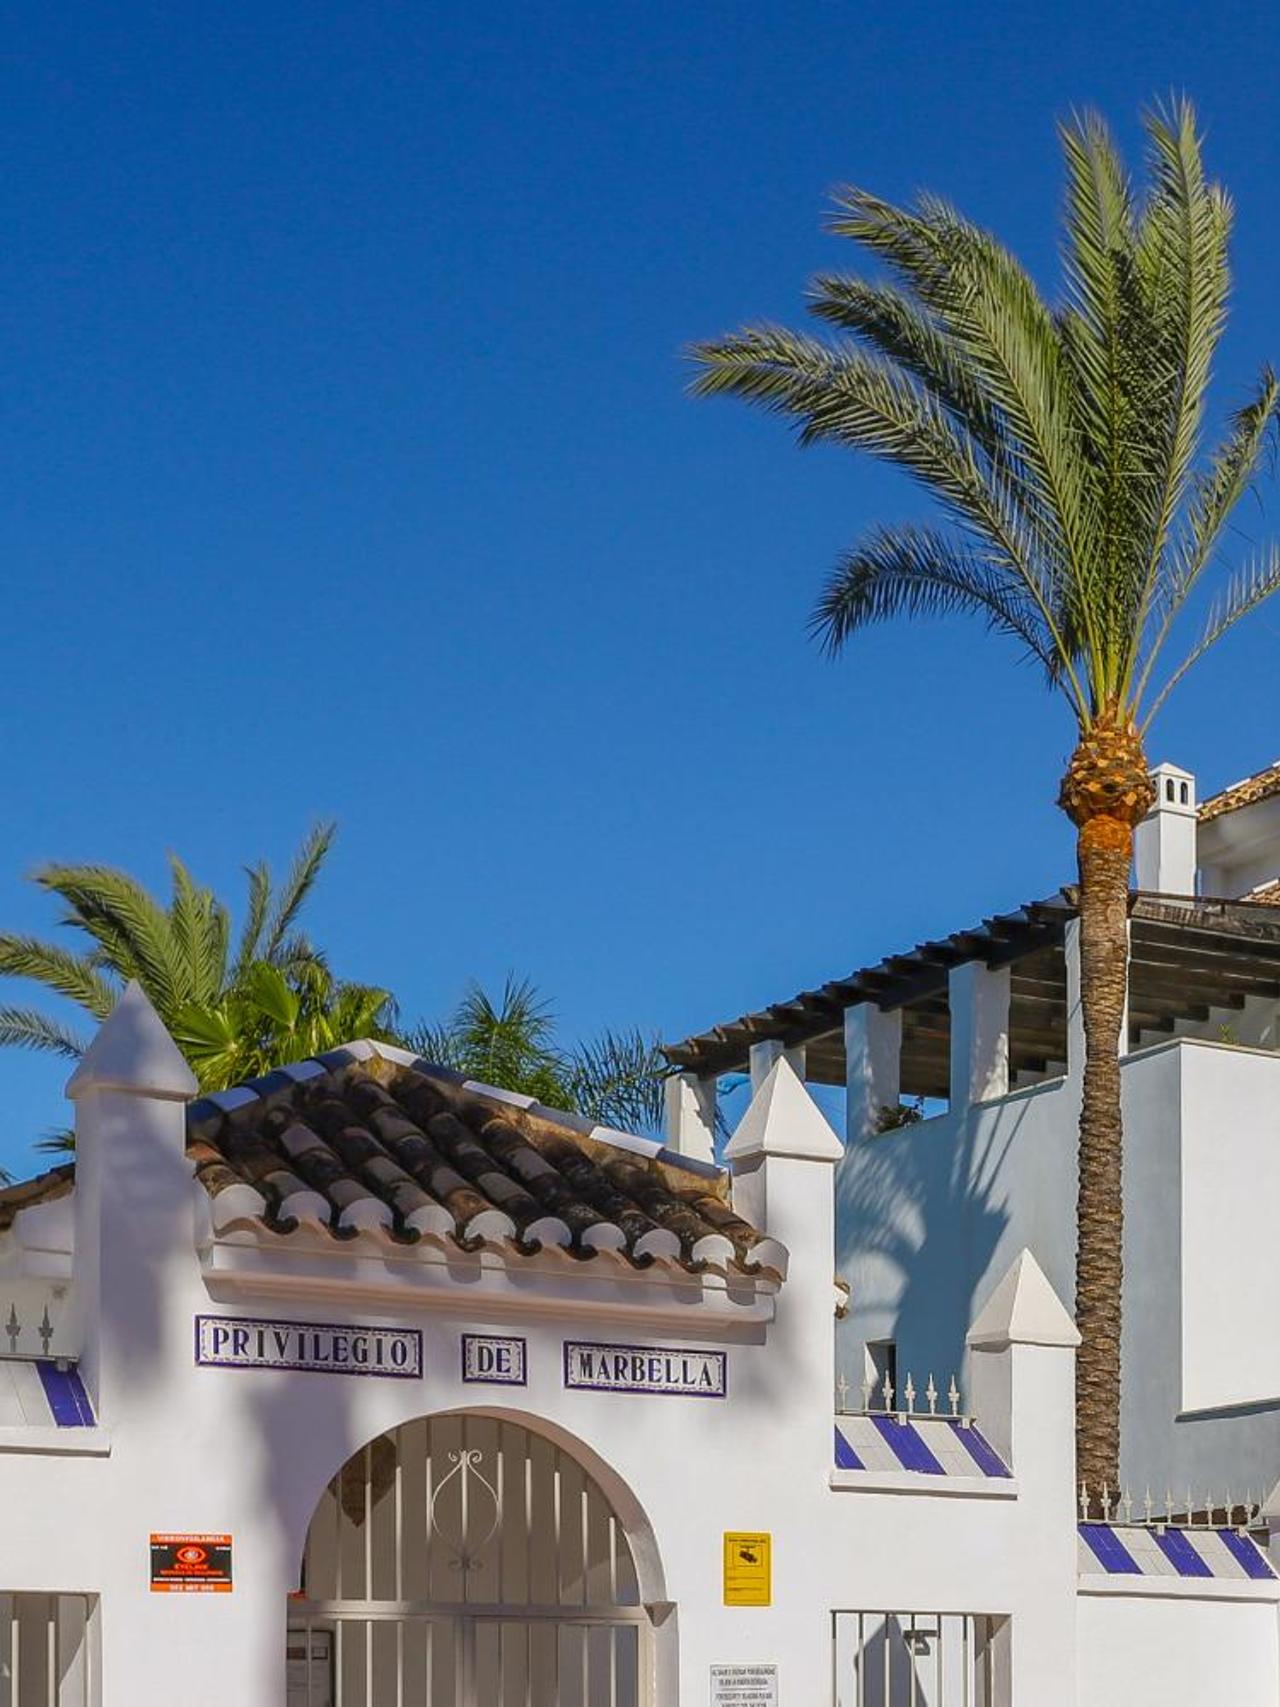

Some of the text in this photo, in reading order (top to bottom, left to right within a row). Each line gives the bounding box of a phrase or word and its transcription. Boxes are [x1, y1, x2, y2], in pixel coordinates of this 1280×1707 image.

[212, 1327, 713, 1387] PRIVILEGIO DE MARBELLA
